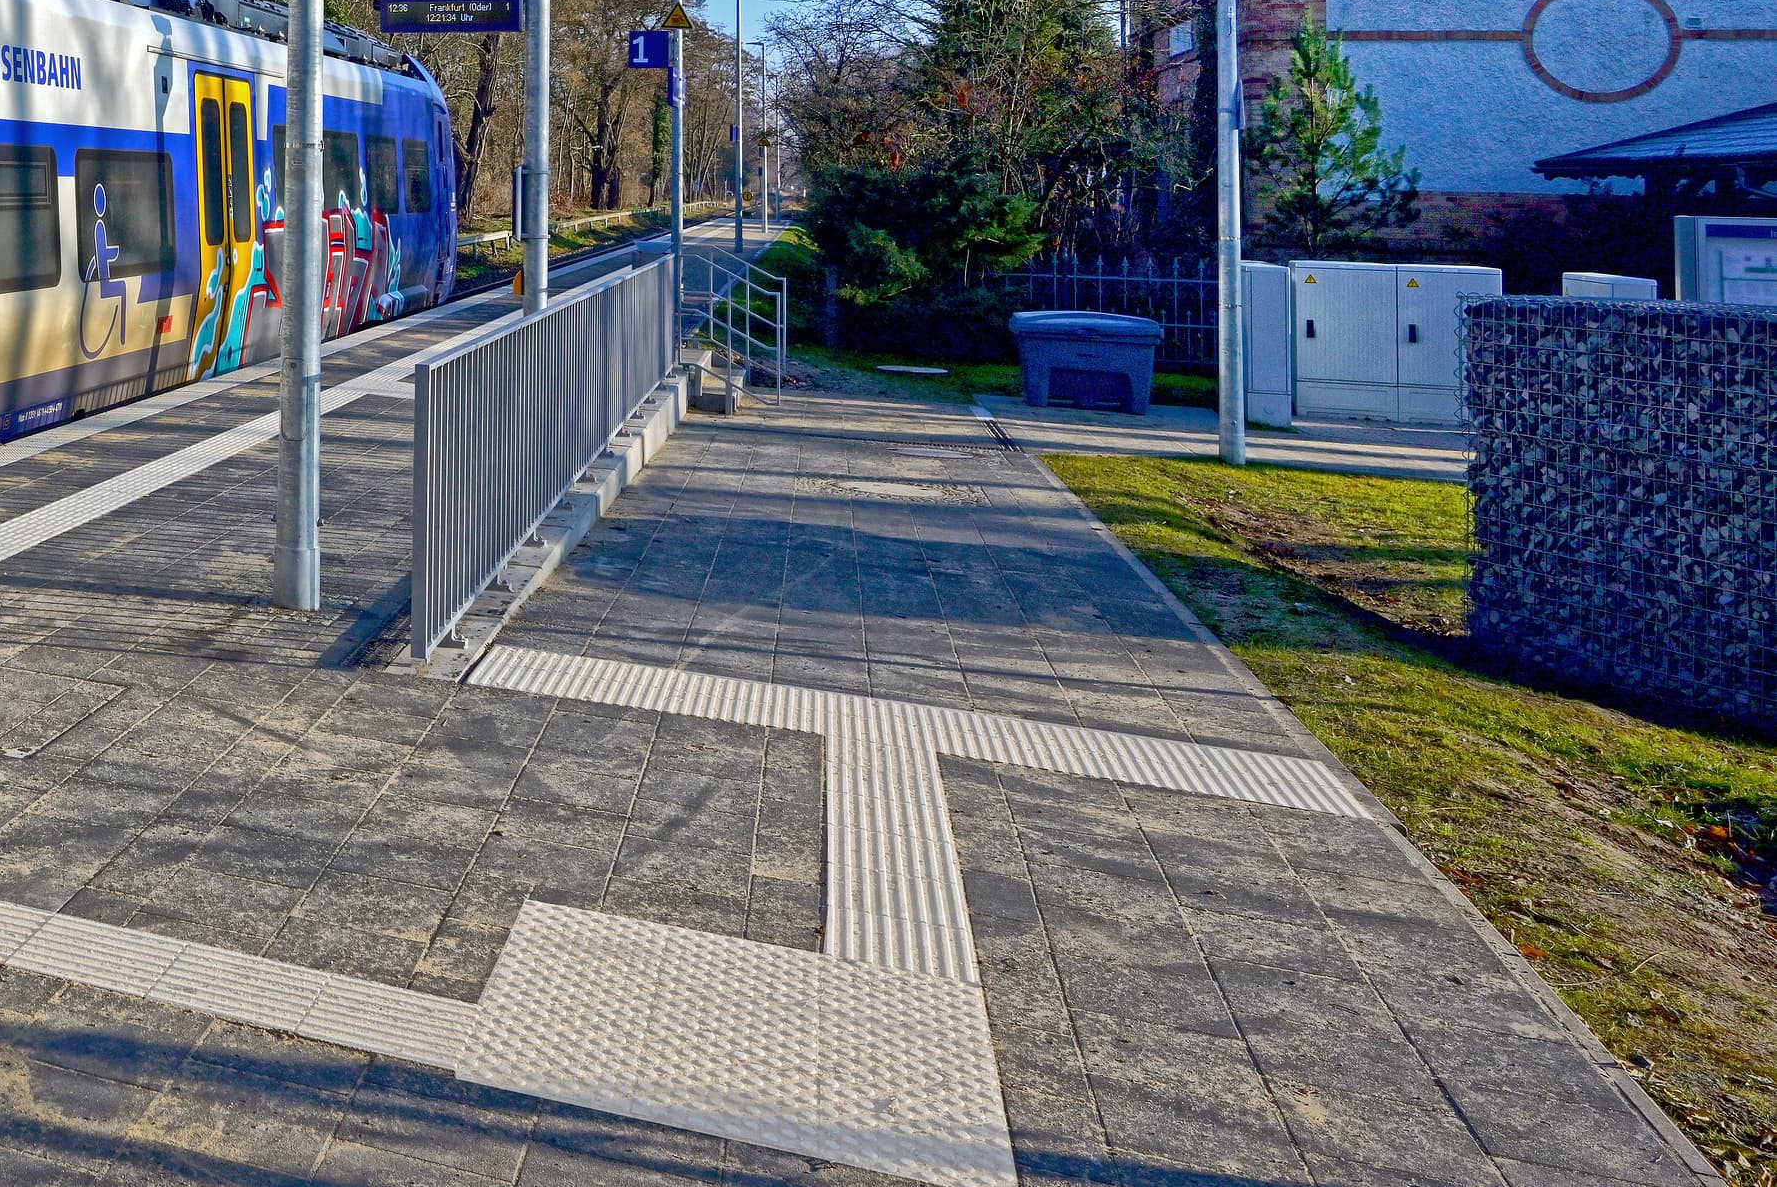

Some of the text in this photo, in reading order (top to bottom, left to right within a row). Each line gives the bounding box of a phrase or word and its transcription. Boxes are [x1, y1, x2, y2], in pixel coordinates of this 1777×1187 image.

[429, 3, 465, 12] Frankfurt
[469, 2, 492, 12] (Oder)
[505, 2, 511, 11] 1
[460, 13, 474, 22] Uhr
[632, 35, 649, 64] 1
